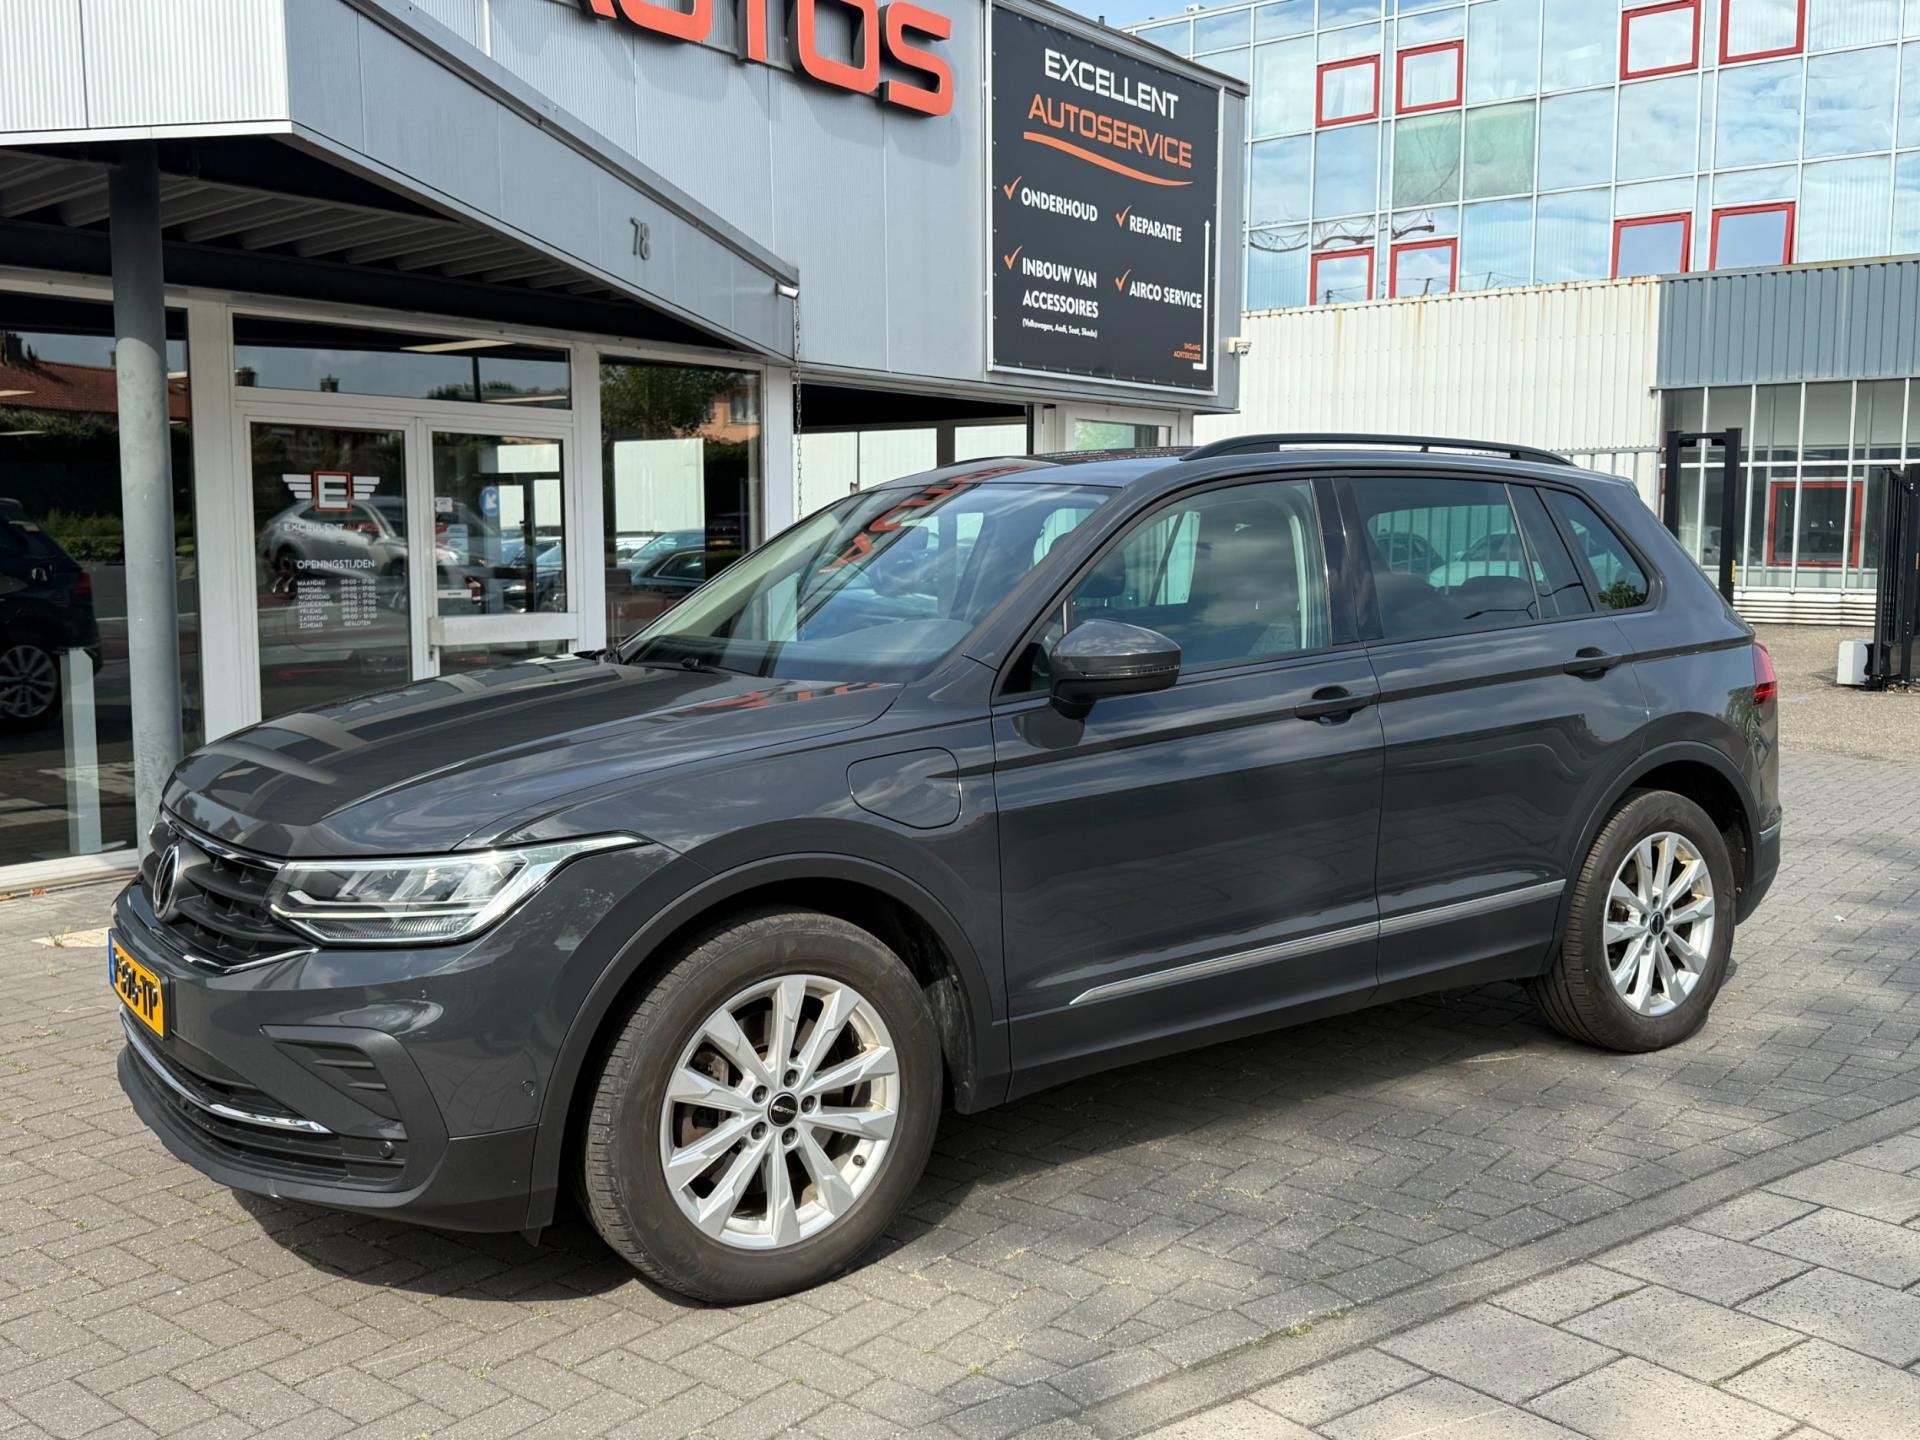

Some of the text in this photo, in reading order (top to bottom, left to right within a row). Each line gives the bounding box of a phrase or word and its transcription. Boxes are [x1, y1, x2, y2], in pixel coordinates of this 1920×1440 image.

[1045, 48, 1179, 119] EXCELLENT
[1028, 93, 1192, 169] AUTOSERVICE
[1021, 187, 1098, 222] ONDERHOUD
[630, 216, 650, 261] 78
[1129, 215, 1182, 243] REPARATIE
[1022, 257, 1097, 289] INBOUW VAN
[1022, 290, 1099, 318] ACCESSOIRES
[1129, 281, 1202, 309] AIRCO SERVICE
[318, 475, 349, 508] E
[297, 559, 376, 569] OPENINGSTIJDEN
